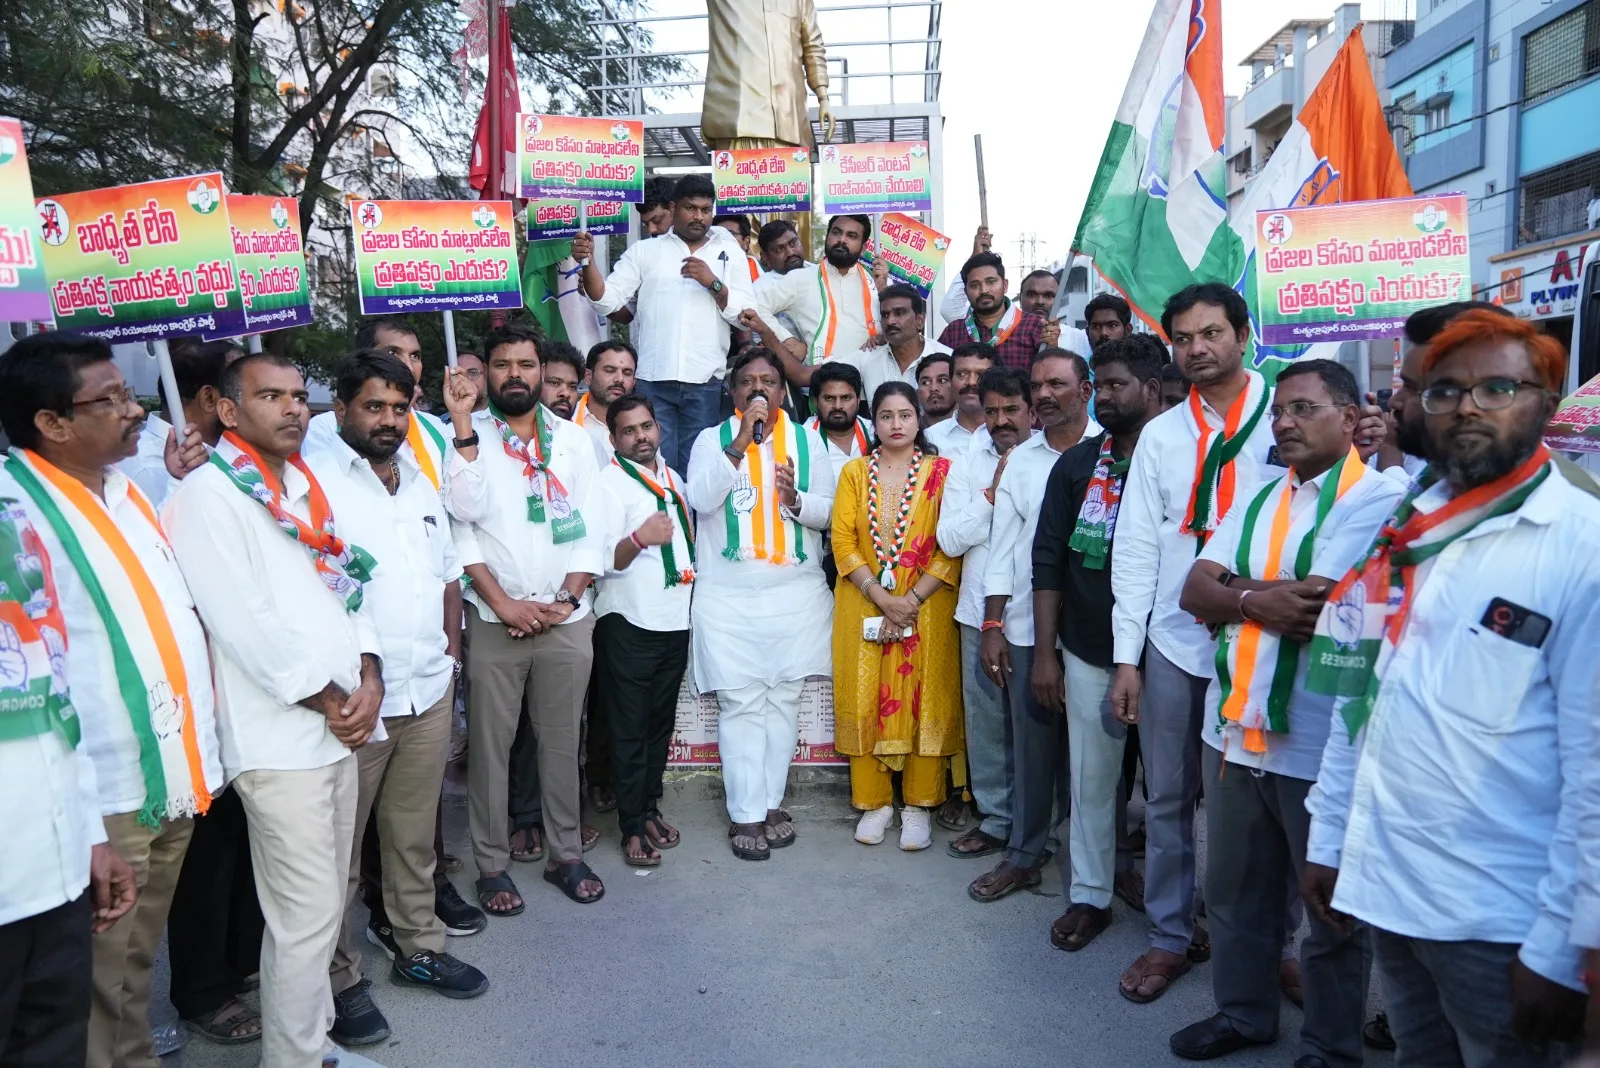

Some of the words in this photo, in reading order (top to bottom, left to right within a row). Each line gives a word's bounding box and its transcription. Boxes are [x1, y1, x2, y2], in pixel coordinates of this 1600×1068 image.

[525, 137, 553, 153] ప్రజల
[556, 136, 582, 153] కోసం
[585, 139, 639, 159] మాట్లాడలేని
[532, 160, 582, 183] ప్రతిపక్షం
[585, 162, 636, 181] ఎందుకు?
[736, 159, 768, 180] బాధ్యత
[770, 155, 785, 173] లేని
[840, 155, 875, 174] కేసీఆర్
[877, 153, 911, 173] వెంటనే
[718, 184, 746, 201] ప్రతిపక్ష
[747, 183, 789, 199] నాయకత్వం
[791, 182, 808, 201] వద్దు!
[828, 180, 882, 196] రాజీనామా
[885, 176, 925, 194] చేయాలి!
[536, 204, 577, 224] ప్రతిపక్షం
[587, 201, 623, 217] ందుకు?
[77, 212, 142, 264] బాధ్యత
[142, 199, 178, 245] లేని
[251, 226, 300, 259] మాట్లాడలేని
[361, 231, 399, 252] ప్రజల
[402, 226, 439, 249] కోసం
[441, 226, 511, 253] మాట్లాడలేని
[880, 220, 911, 246] బాధ్యత
[910, 231, 926, 251] లేని
[1265, 247, 1313, 273] ప్రజల
[1316, 238, 1364, 266] కోసం
[1368, 229, 1467, 267] మాట్లాడలేని
[257, 267, 300, 294] ఎందుకు?
[374, 260, 441, 290] ప్రతిపక్షం
[444, 259, 509, 282] ఎందుకు?
[53, 272, 113, 316] ప్రతిపక్ష
[110, 267, 193, 306] నాయకత్వం
[196, 262, 234, 307] వద్దు!
[1279, 279, 1365, 315] ప్రతిపక్షం
[1369, 272, 1462, 303] ఎందుకు?
[198, 315, 216, 330] పార్టీ
[1075, 526, 1103, 538] CONGRESS
[667, 746, 692, 760] CPM
[793, 746, 811, 760] PM
